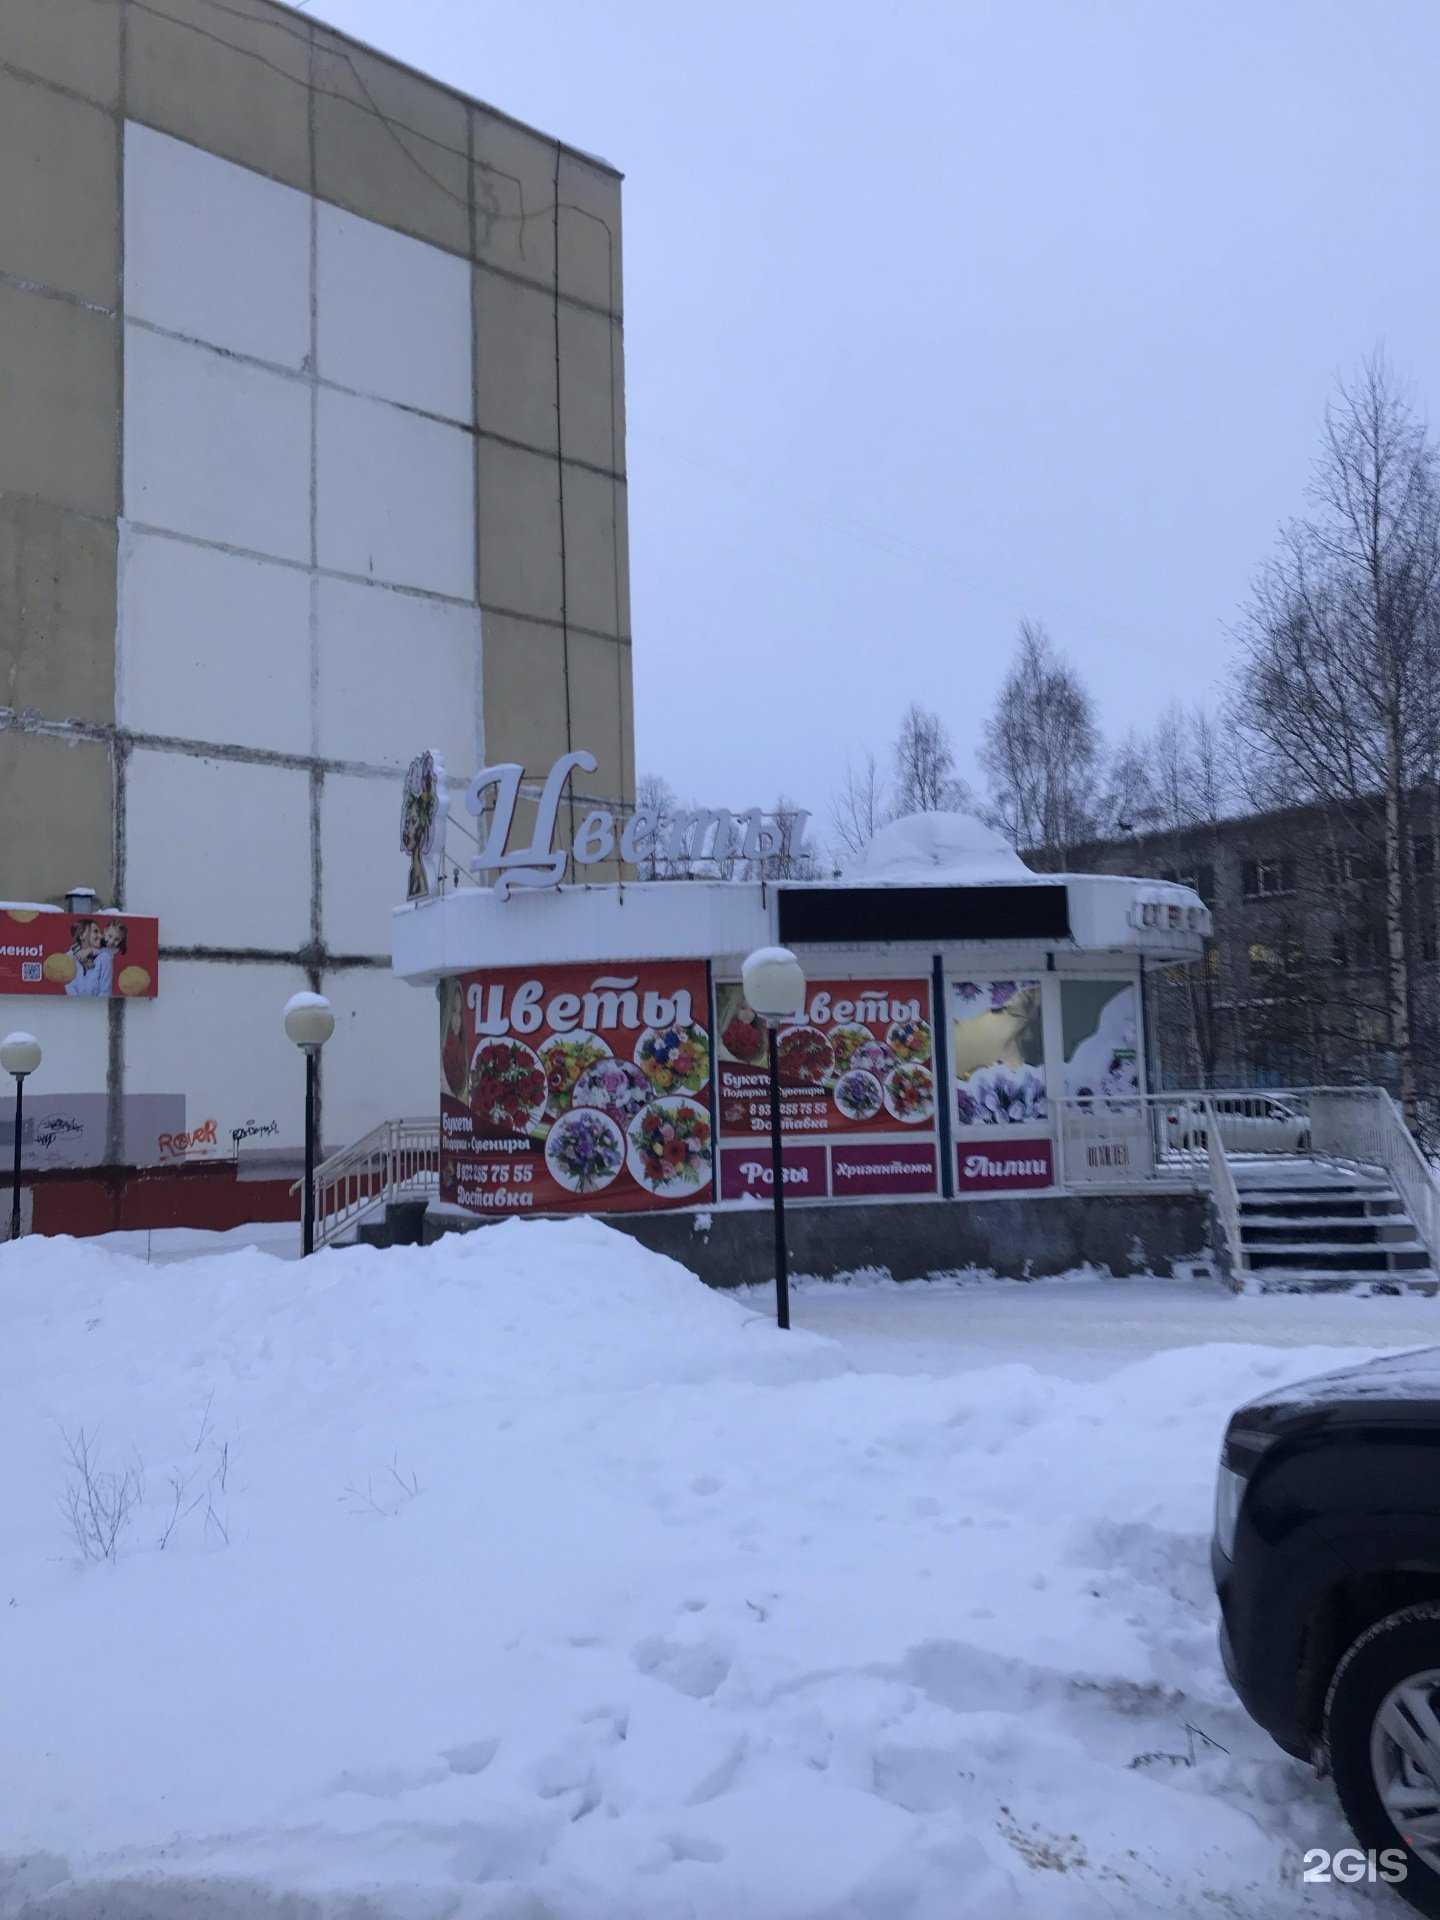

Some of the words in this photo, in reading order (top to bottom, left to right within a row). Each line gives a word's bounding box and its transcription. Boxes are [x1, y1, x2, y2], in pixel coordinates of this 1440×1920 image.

[465, 750, 812, 900] Цветы
[467, 976, 694, 1036] Цветы
[779, 1087, 825, 1099] увениры
[800, 1103, 812, 1115] 75
[814, 1102, 828, 1114] 55
[442, 1112, 473, 1136] Букеты
[751, 1117, 828, 1131] Дотавка
[471, 1136, 531, 1154] Сувениры
[491, 1164, 511, 1183] 75
[513, 1164, 534, 1183] 55
[836, 1160, 933, 1179] Хризантемы
[964, 1155, 1047, 1178] Лилии
[457, 1185, 534, 1208] Доставка
